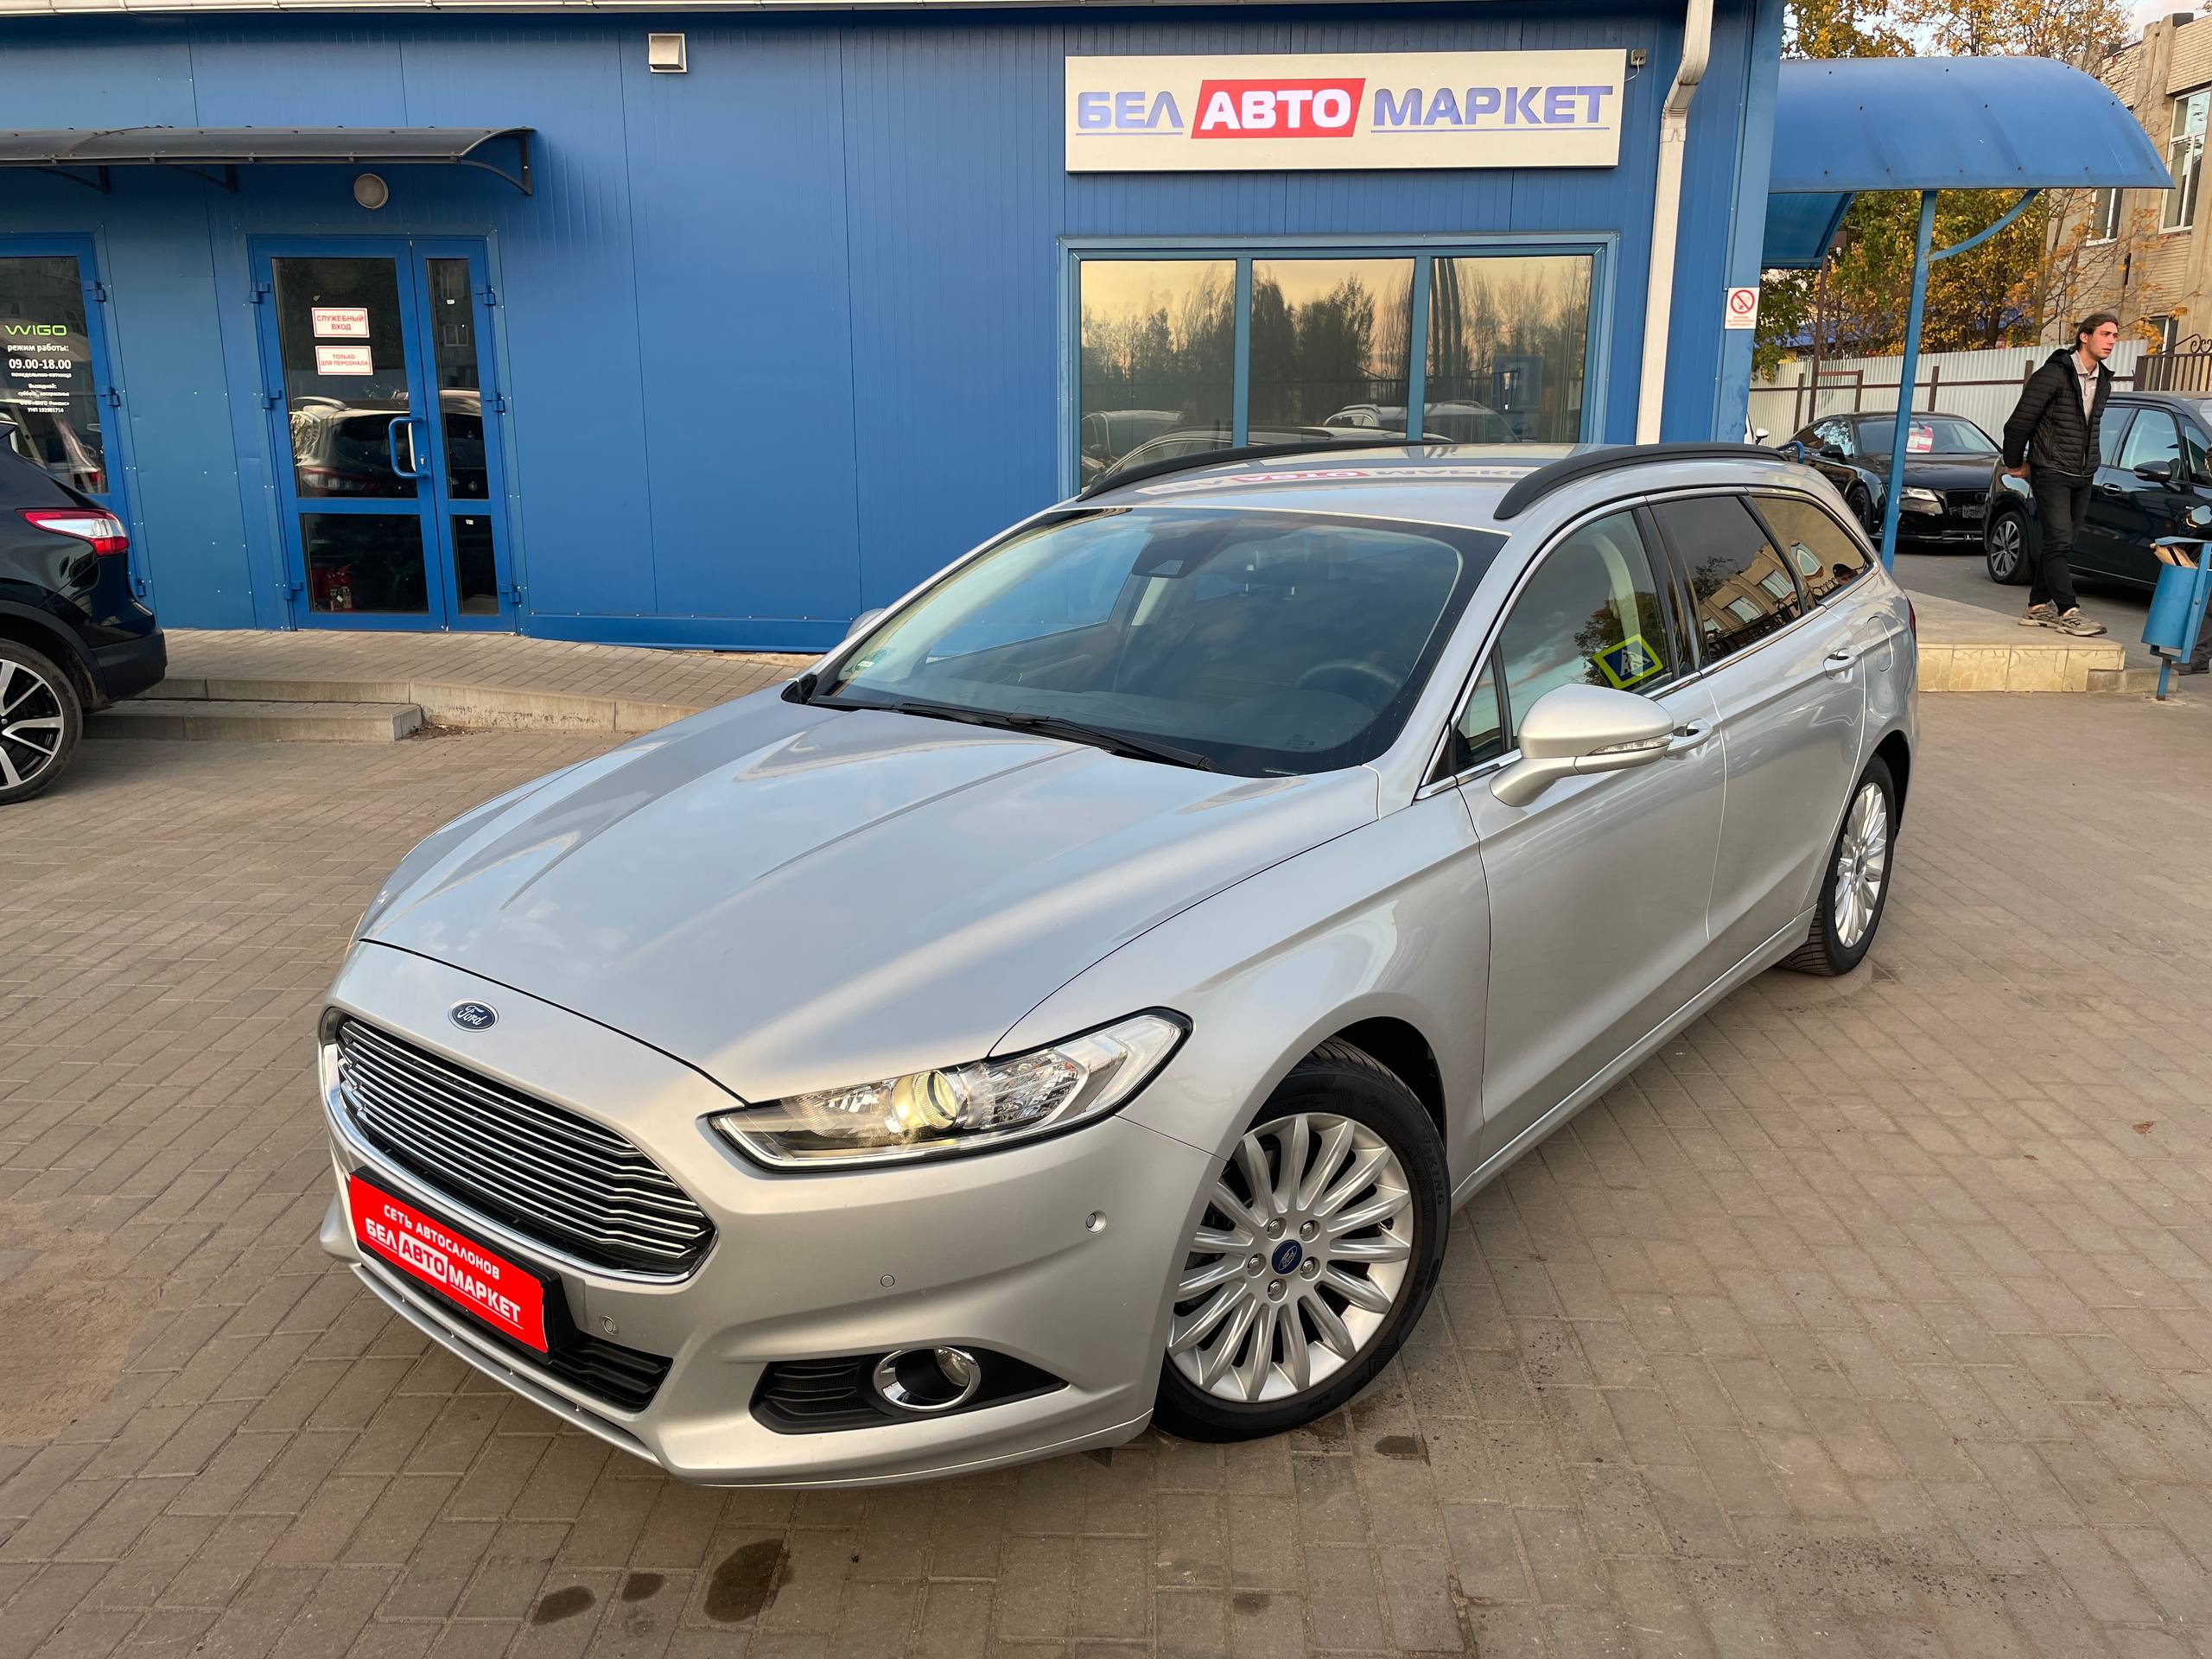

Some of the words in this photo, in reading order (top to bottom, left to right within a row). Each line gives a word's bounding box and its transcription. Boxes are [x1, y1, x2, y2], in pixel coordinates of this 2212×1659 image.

[1077, 91, 1184, 129] БЕЛ
[1199, 88, 1351, 130] АВТО
[1374, 85, 1613, 126] МАРКЕТ
[4, 324, 67, 336] WIGO
[36, 343, 69, 353] работы:
[8, 358, 72, 370] 09.00-18.00
[456, 1005, 487, 1026] Ford
[384, 1204, 413, 1229] СЕТЬ
[416, 1222, 500, 1281] АВТОСАЛОНОВ
[365, 1217, 398, 1250] БЕЛ
[400, 1238, 445, 1274] АВТО
[448, 1264, 521, 1323] МАРКЕТ
